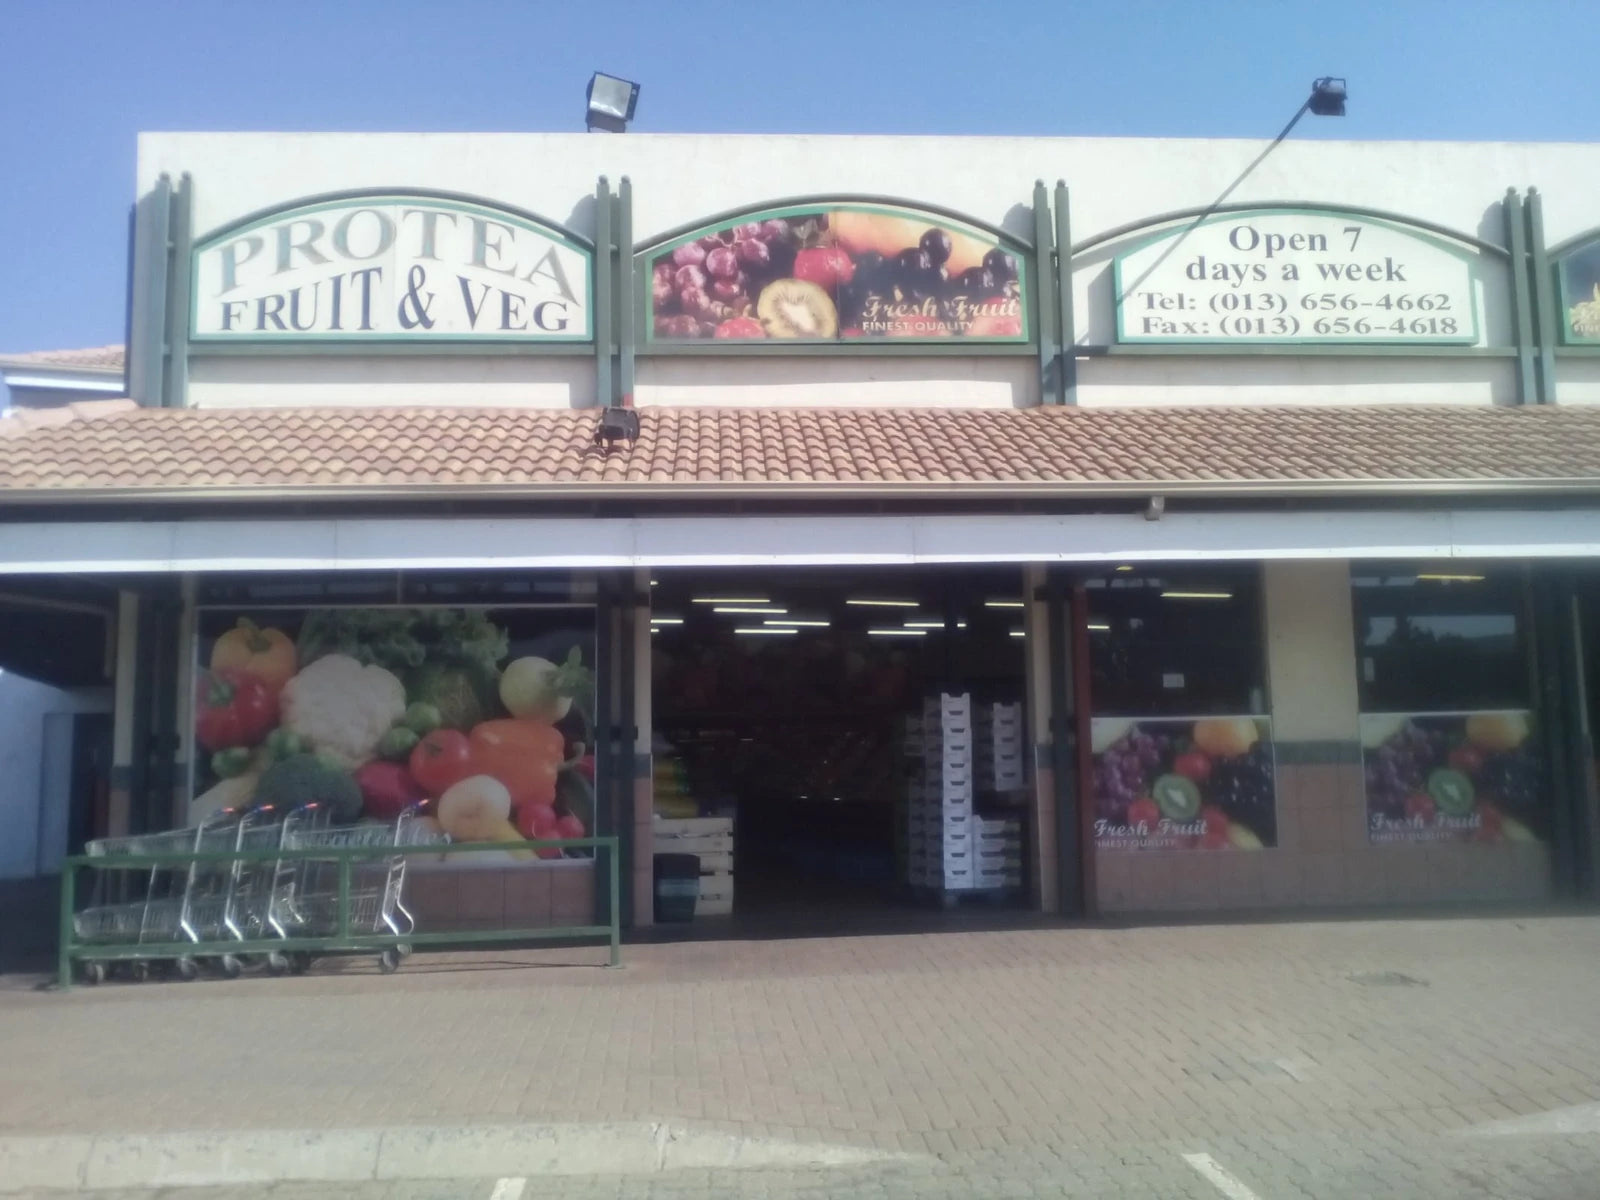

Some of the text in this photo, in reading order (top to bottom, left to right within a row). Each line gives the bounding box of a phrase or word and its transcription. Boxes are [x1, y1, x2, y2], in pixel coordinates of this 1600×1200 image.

[1228, 225, 1362, 259] Open 7
[213, 208, 582, 308] PROTEA
[1185, 255, 1408, 289] days a week
[217, 263, 570, 332] FRUIT & VEG
[862, 295, 1018, 319] Fresh Fruit
[1137, 292, 1452, 314] Tel: (013) 656-4662
[862, 321, 975, 331] FINEST QUALITY
[1142, 315, 1459, 336] Fax: (013) 656-4618
[1094, 818, 1209, 837] Fresh Fruit
